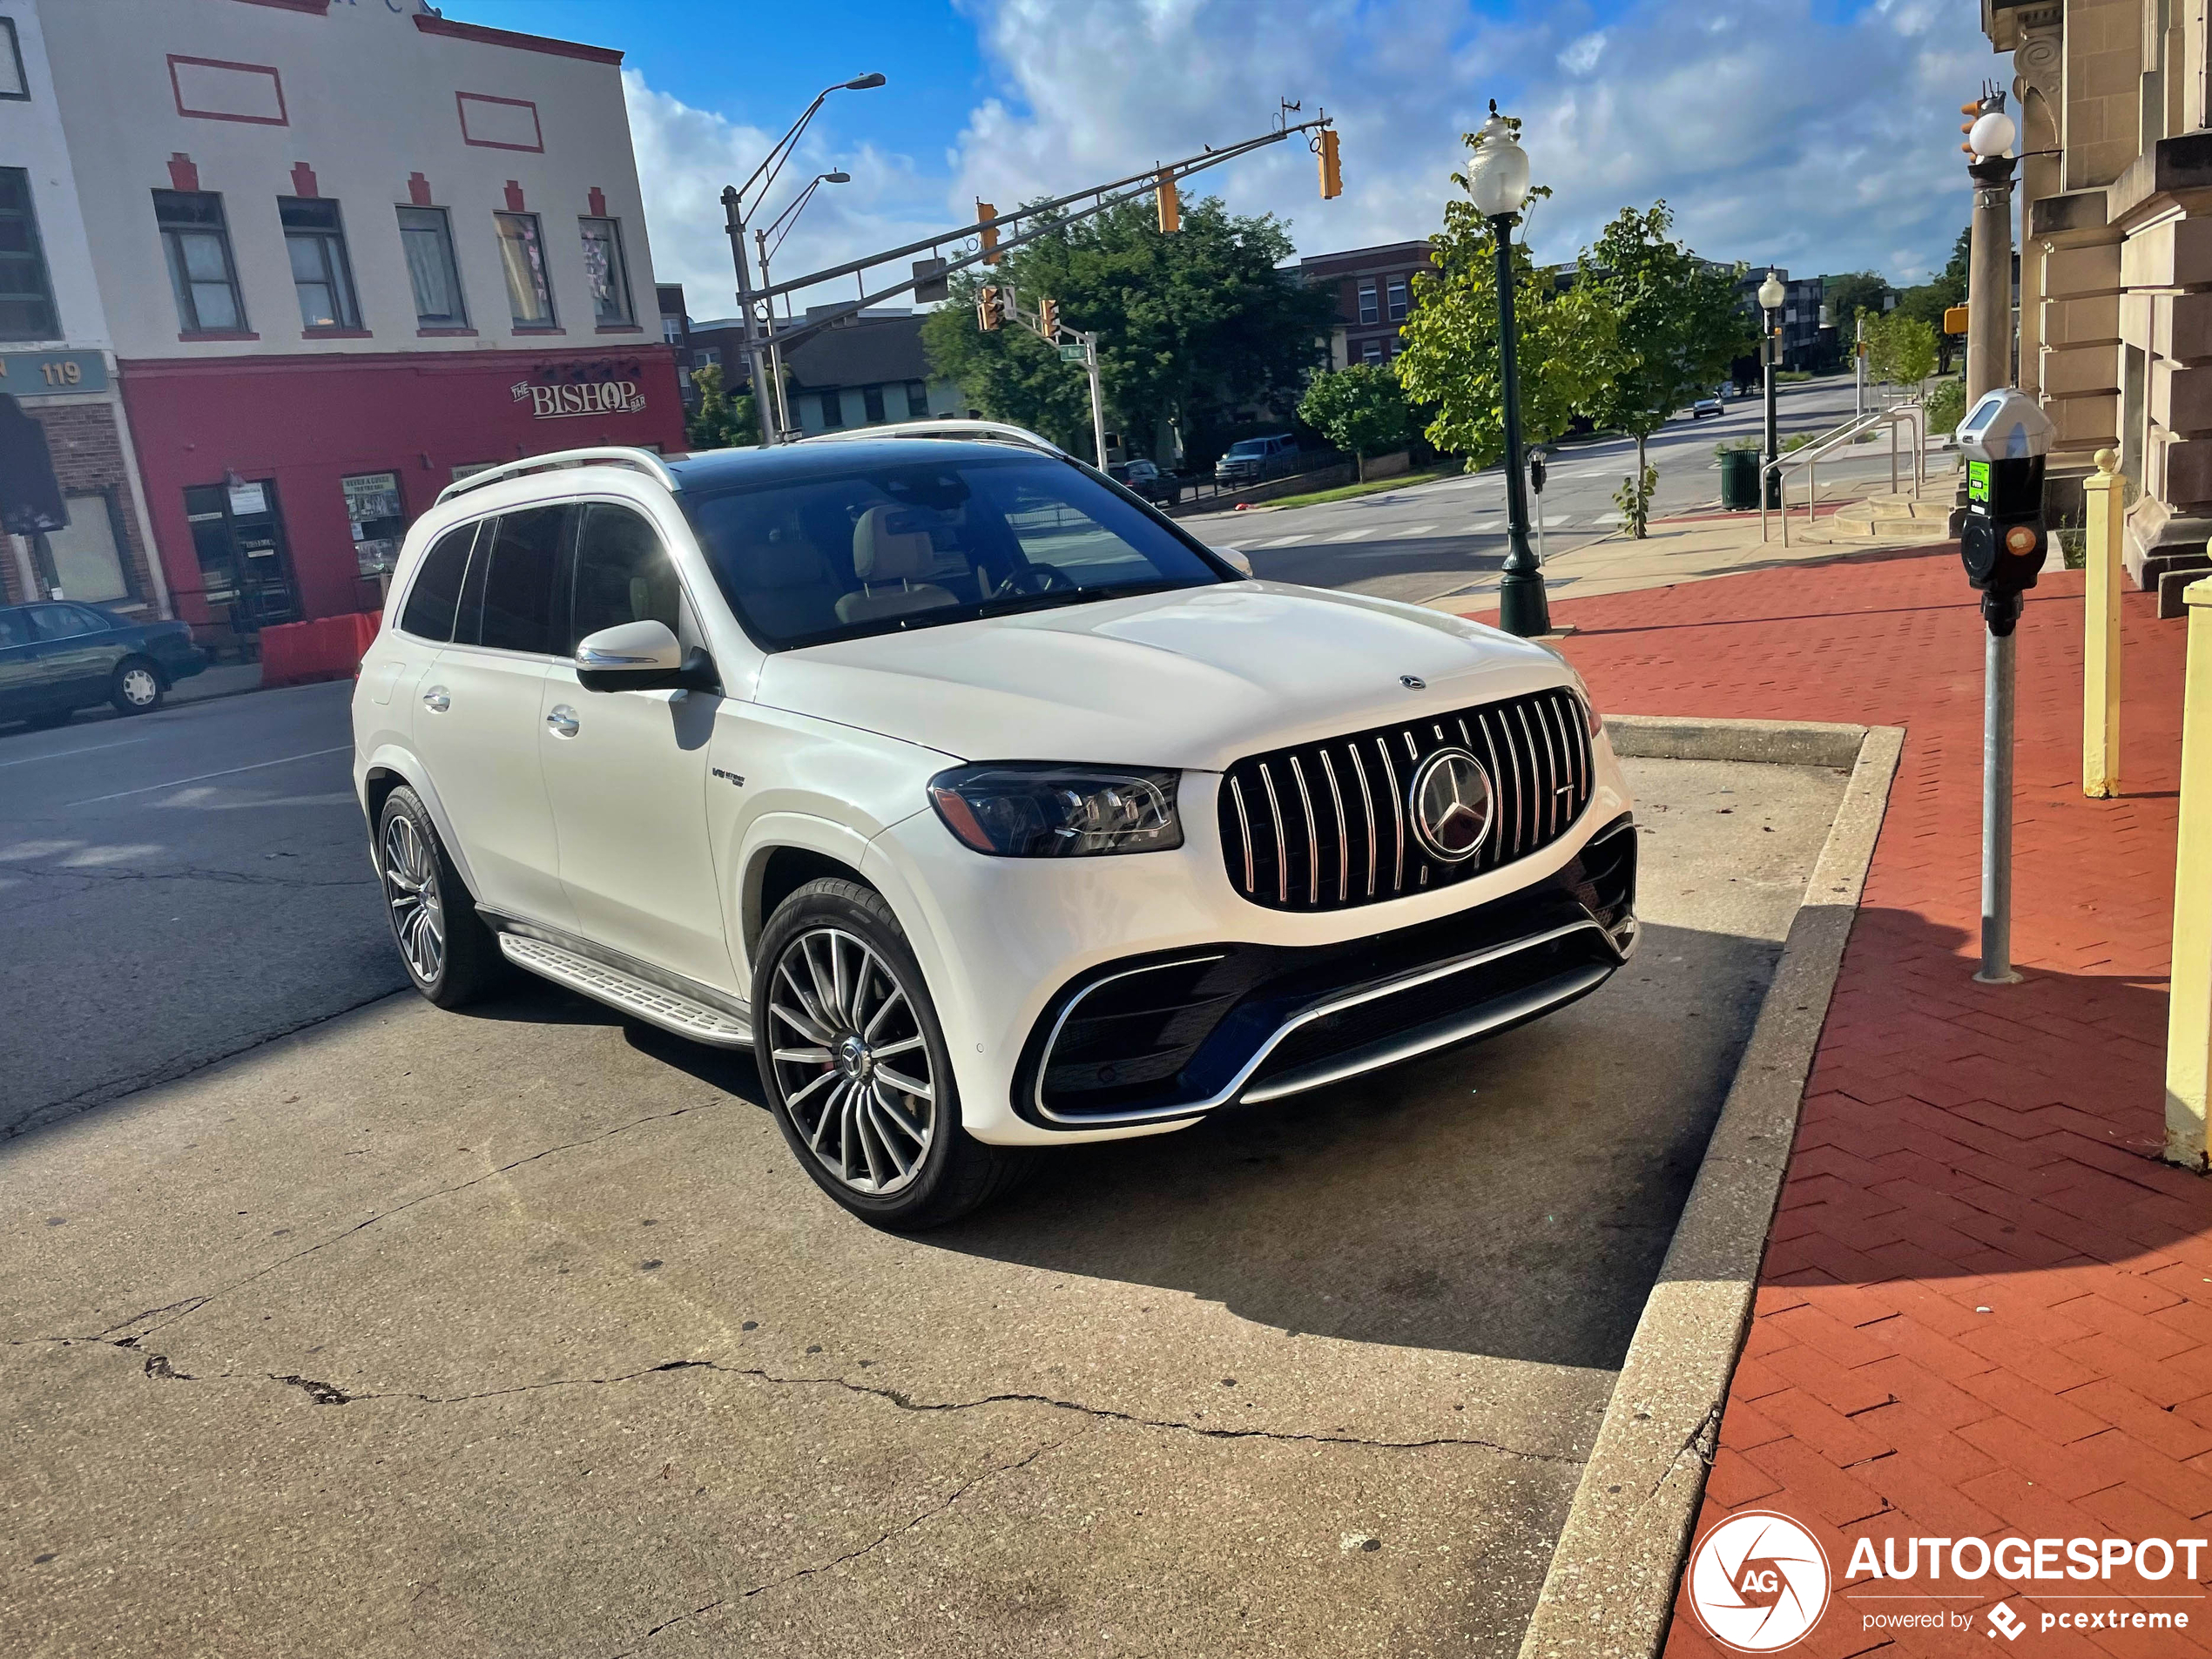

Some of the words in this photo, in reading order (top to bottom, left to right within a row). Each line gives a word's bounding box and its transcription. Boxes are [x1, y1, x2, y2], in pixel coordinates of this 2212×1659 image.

[41, 361, 81, 386] 119
[511, 383, 529, 400] THE
[529, 381, 636, 415] BISHOP
[631, 395, 646, 410] BAR
